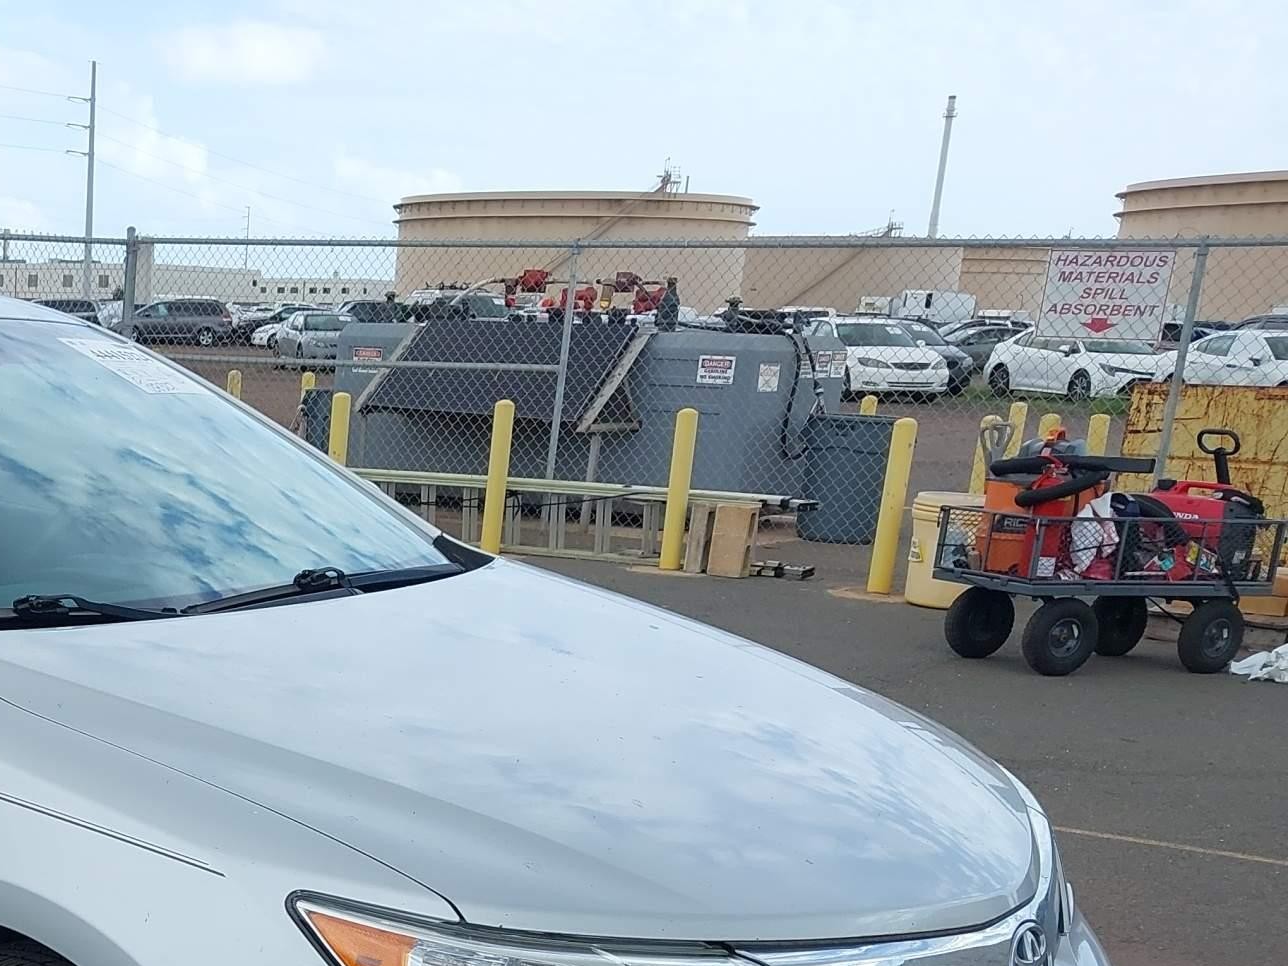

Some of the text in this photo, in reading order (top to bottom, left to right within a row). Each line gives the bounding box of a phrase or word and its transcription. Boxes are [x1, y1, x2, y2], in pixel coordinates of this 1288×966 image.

[1054, 254, 1169, 268] HAZARDOUS
[1057, 271, 1160, 284] MATERIALS
[1079, 287, 1129, 300] SPILL
[1045, 303, 1159, 317] ABSORBENT
[1173, 511, 1199, 519] NDA
